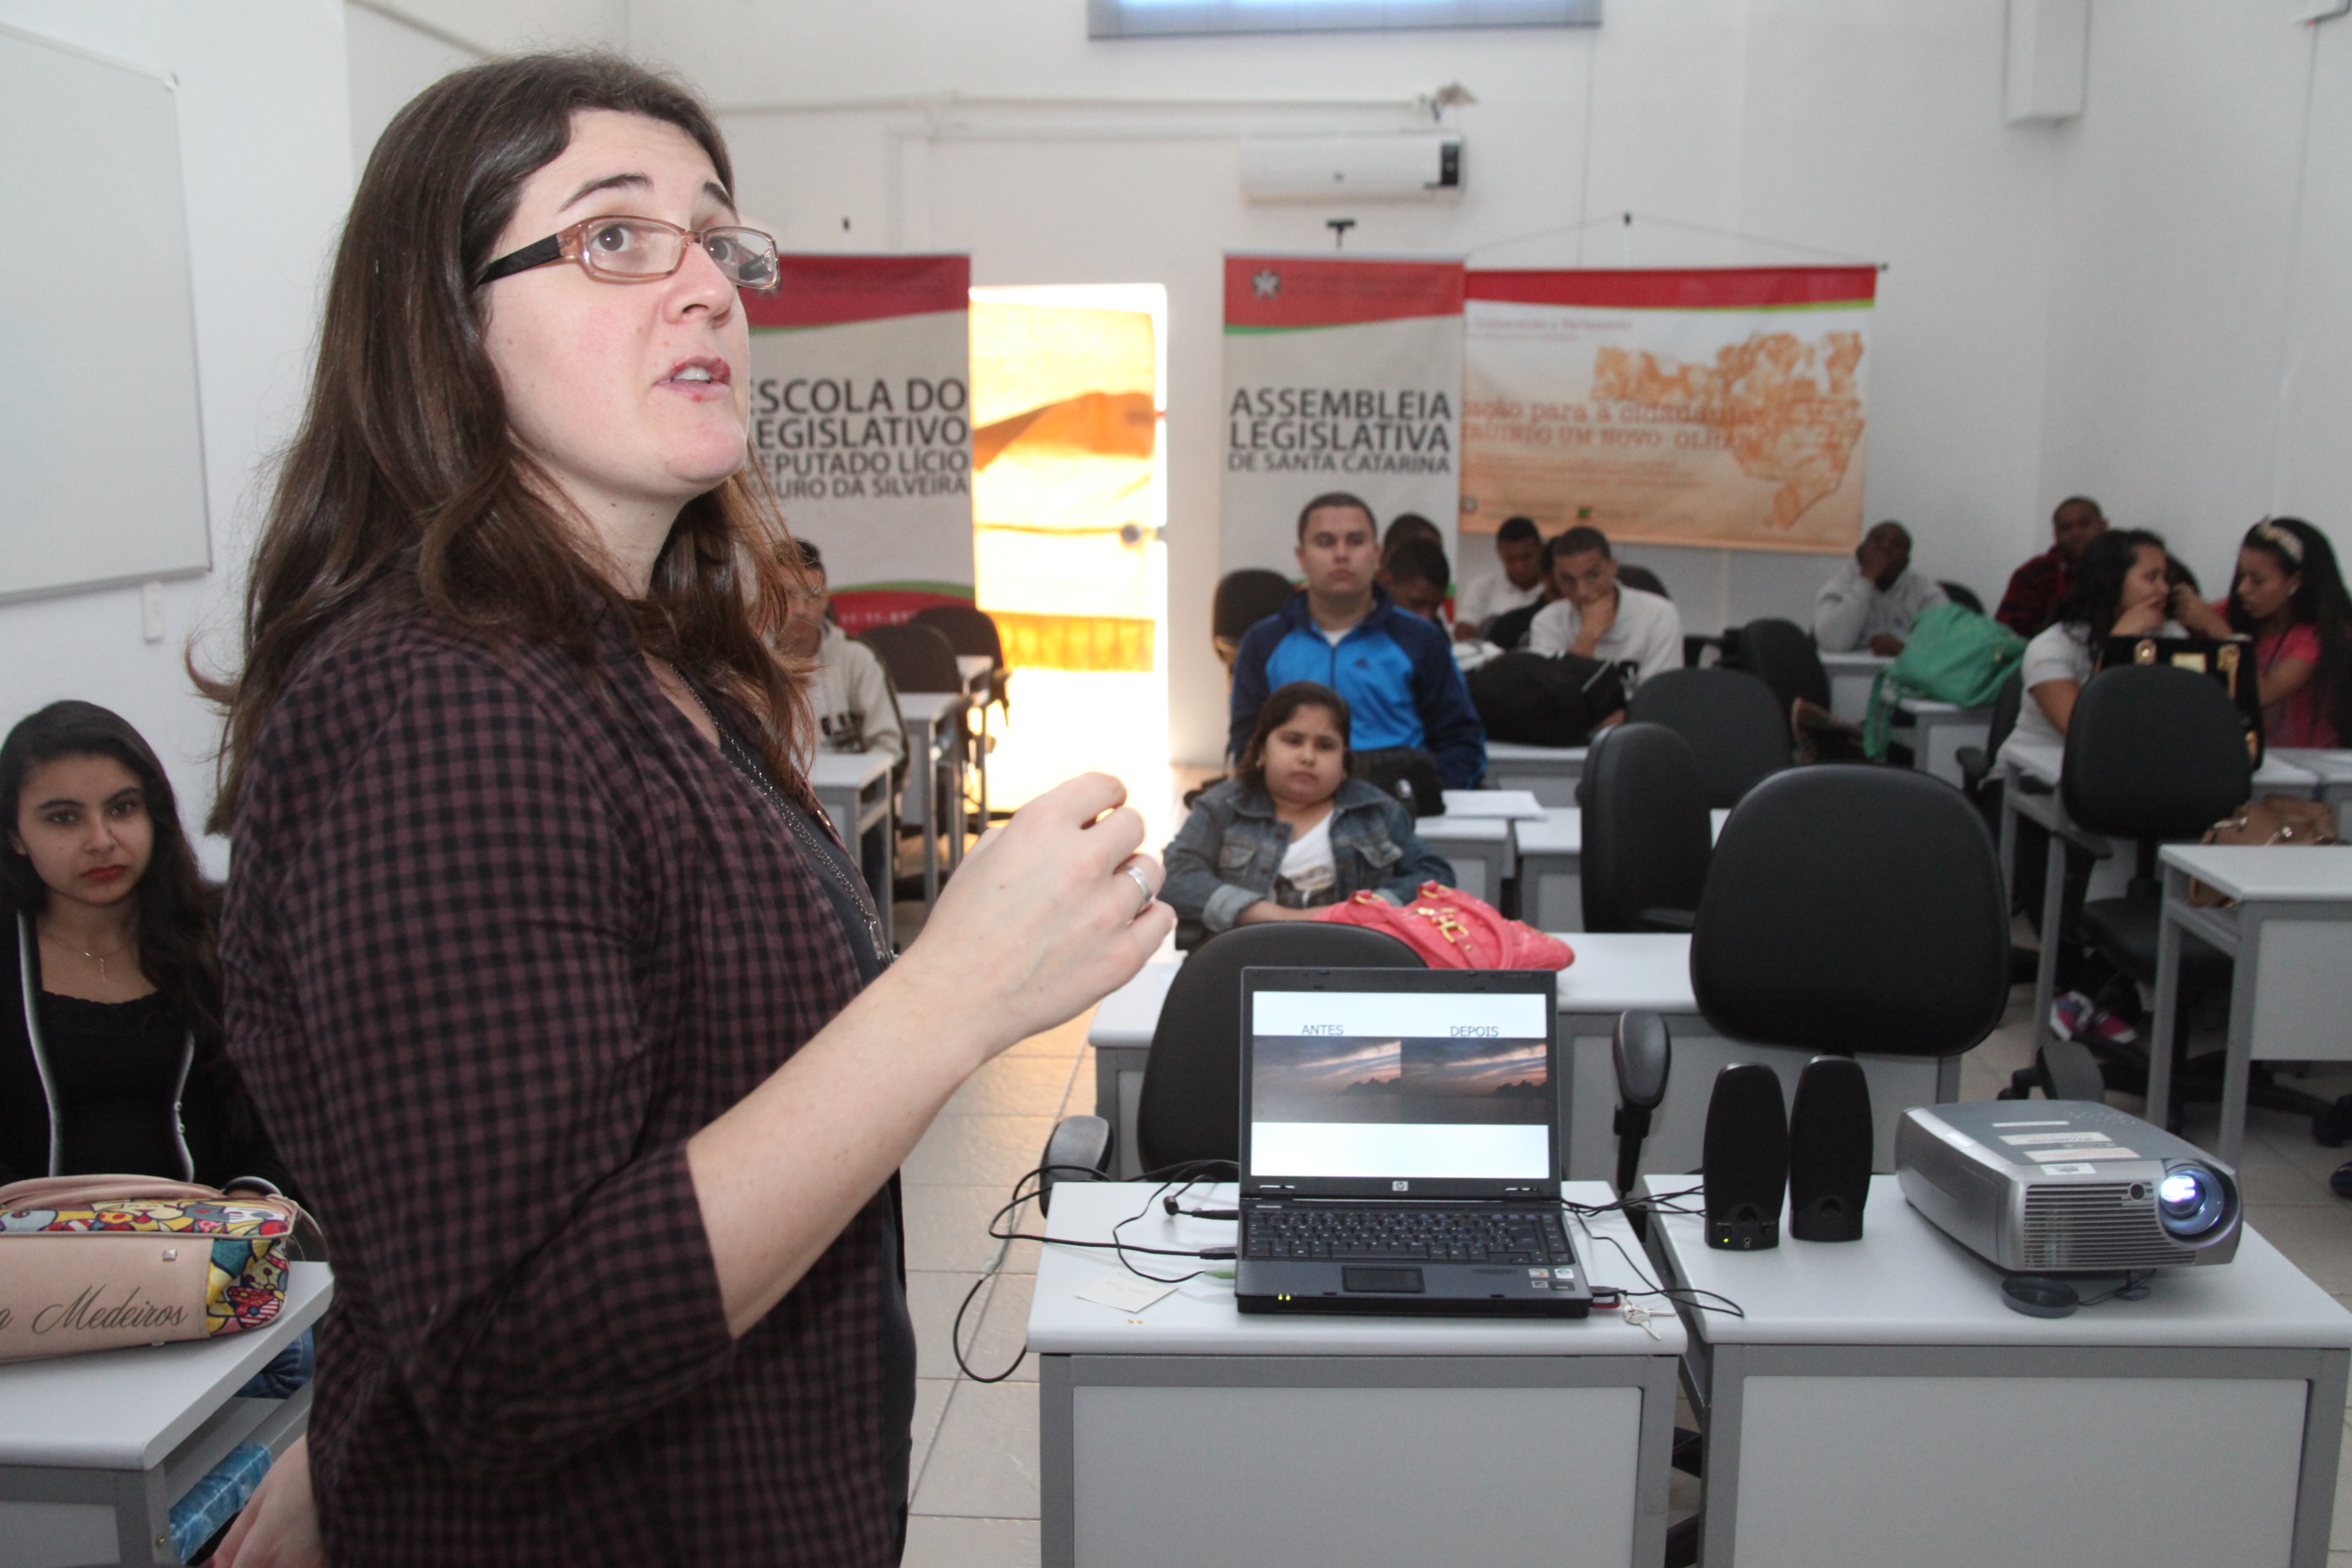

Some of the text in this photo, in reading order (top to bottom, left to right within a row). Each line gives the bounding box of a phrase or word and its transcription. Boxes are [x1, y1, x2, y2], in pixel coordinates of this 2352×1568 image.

[750, 378, 966, 415] SCOLA DO
[1229, 387, 1452, 421] ASSEMBLEIA
[757, 416, 968, 450] EGISLATIVO
[1229, 420, 1451, 453] LEGISLATIVA
[761, 445, 970, 476] EPUTADO LÍCIO
[1228, 452, 1256, 472] DE
[1262, 453, 1337, 473] SANTA
[1342, 453, 1452, 474] CATARINA
[775, 474, 970, 499] URO DA SILVEIRA
[1301, 1024, 1499, 1037] ANTES DEPOIS
[31, 1283, 188, 1334] Medeiros
